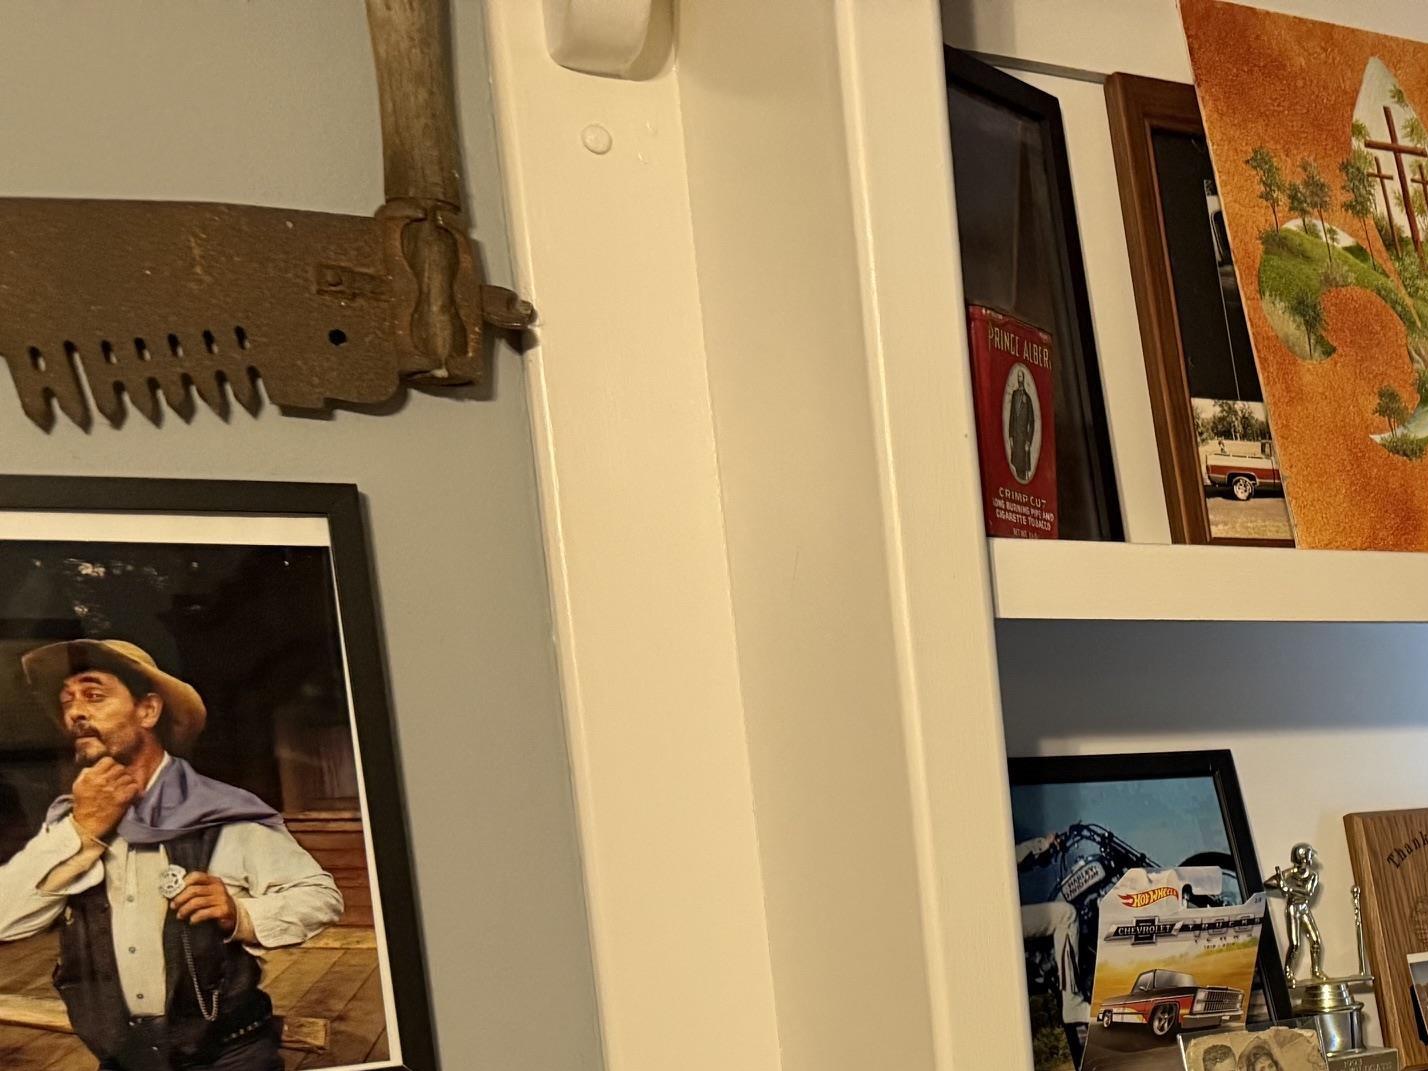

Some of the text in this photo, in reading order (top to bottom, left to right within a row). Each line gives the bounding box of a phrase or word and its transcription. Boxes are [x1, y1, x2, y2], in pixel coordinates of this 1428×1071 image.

[988, 320, 1020, 357] PRINCE
[999, 487, 1046, 508] CRIMP CUT
[1042, 511, 1055, 522] AND
[1133, 887, 1178, 907] HOT WHEELS
[1118, 925, 1171, 936] CHEVROLET
